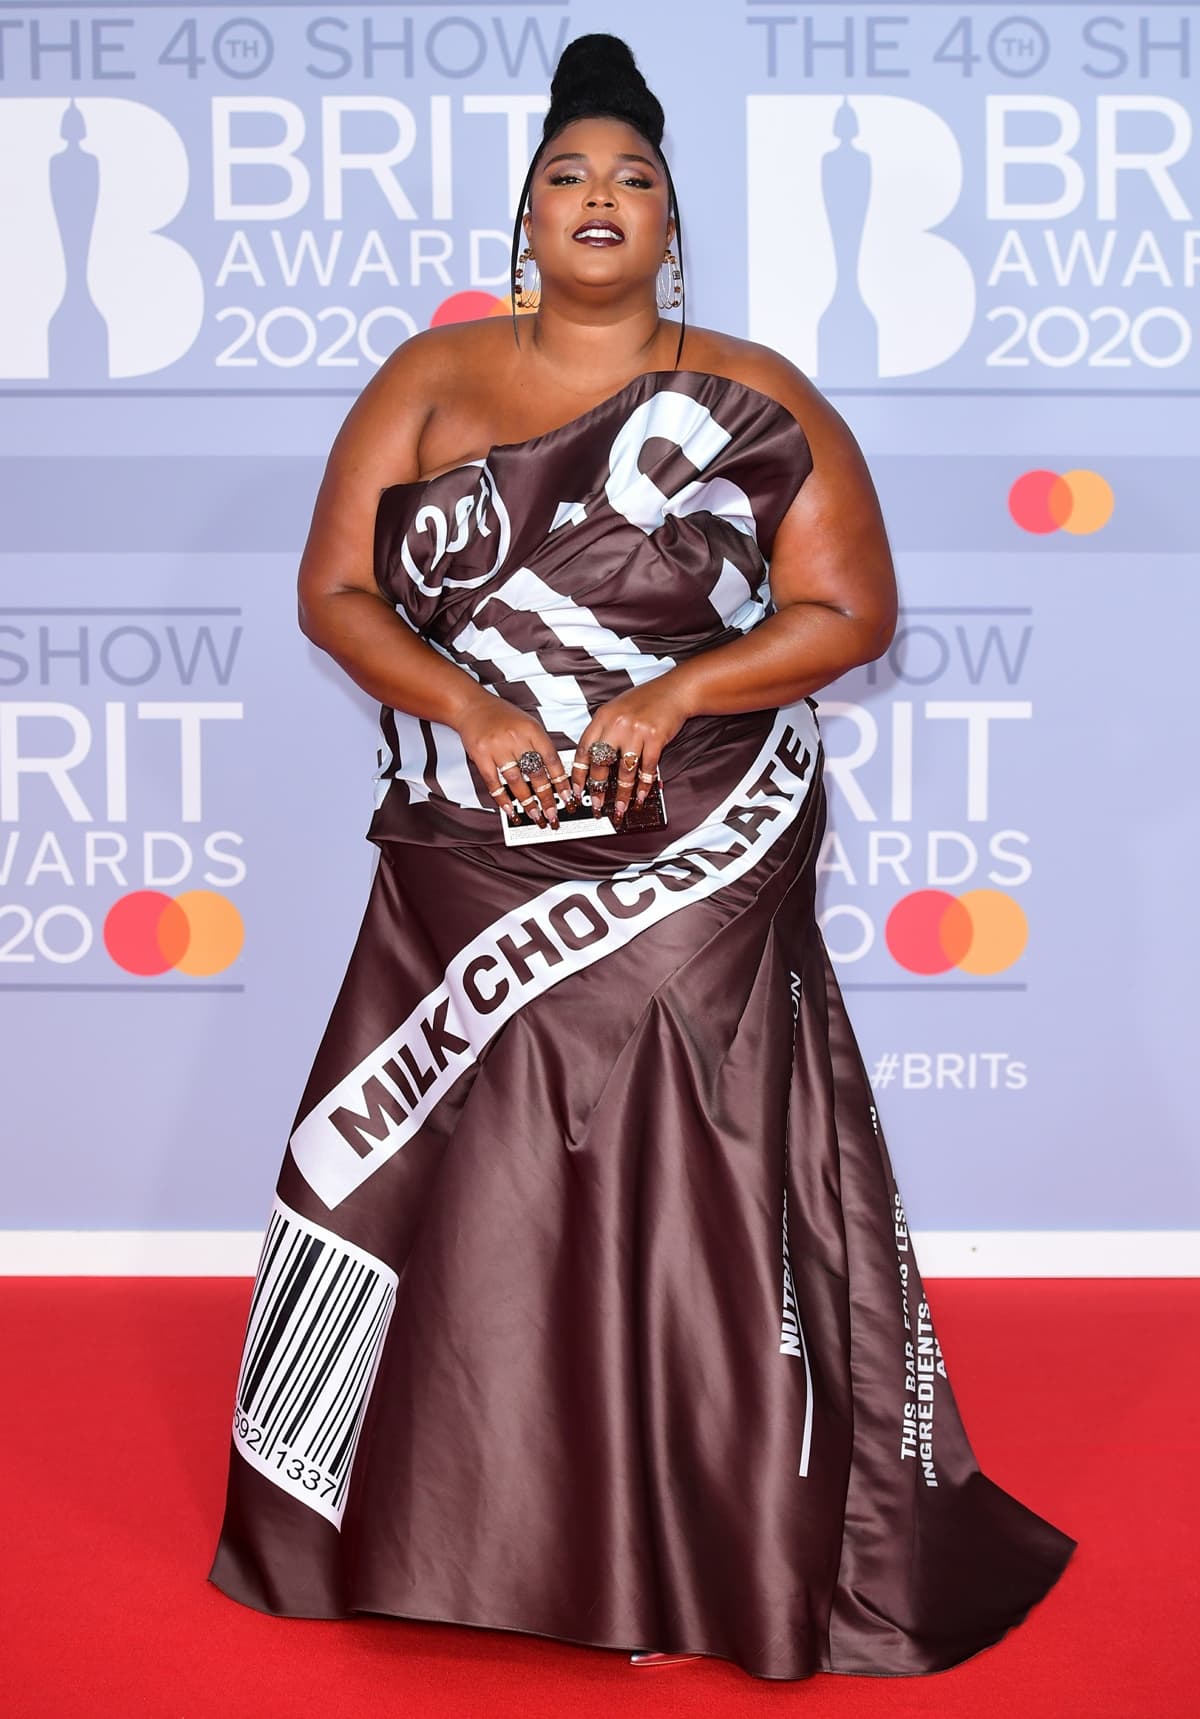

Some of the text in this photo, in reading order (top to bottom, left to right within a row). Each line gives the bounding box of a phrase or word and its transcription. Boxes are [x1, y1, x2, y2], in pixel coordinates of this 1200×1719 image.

[305, 16, 570, 80] SHOW
[746, 16, 910, 78] THE
[211, 96, 552, 220] BRIT
[215, 229, 516, 287] AWARD
[215, 306, 416, 367] 2020
[985, 306, 1192, 368] 2020
[866, 625, 1033, 686] OW
[0, 831, 247, 887] ARDS
[328, 996, 470, 1159] MILK
[462, 725, 811, 1015] CHOCOLATE
[870, 1053, 1028, 1089] #BRITs
[905, 1341, 916, 1392] BAR
[901, 1402, 917, 1460] THIS
[277, 1451, 337, 1498] 1337
